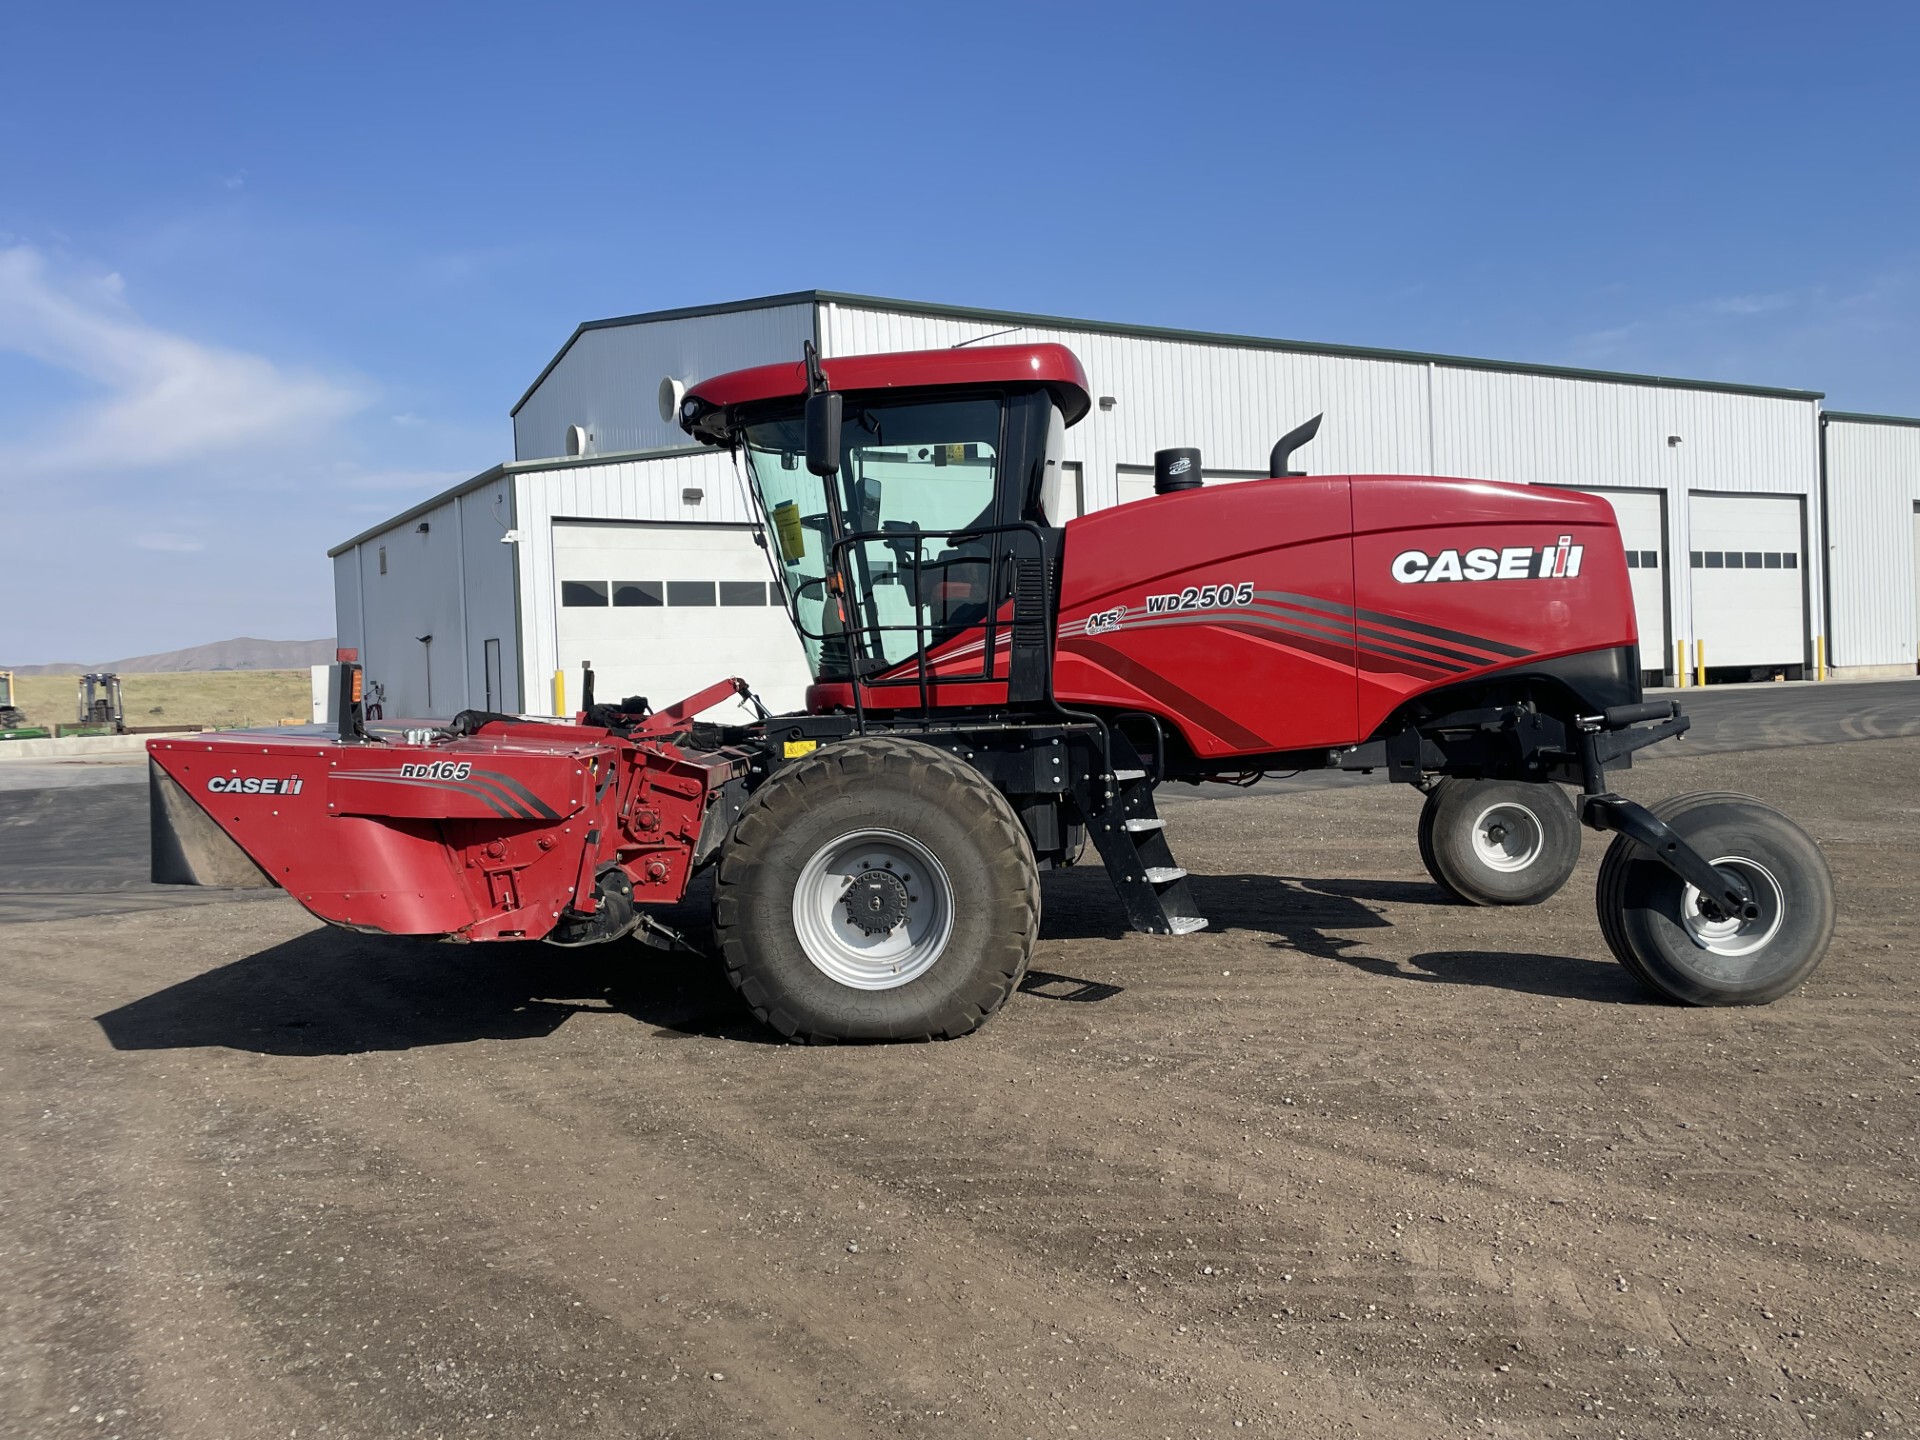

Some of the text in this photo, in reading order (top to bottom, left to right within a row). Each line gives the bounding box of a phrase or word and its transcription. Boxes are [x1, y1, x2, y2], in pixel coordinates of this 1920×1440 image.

[1391, 546, 1534, 583] CASE
[1146, 582, 1254, 613] WD2505
[1087, 610, 1118, 628] AFS
[400, 761, 472, 781] RD165
[207, 776, 279, 794] CASE
